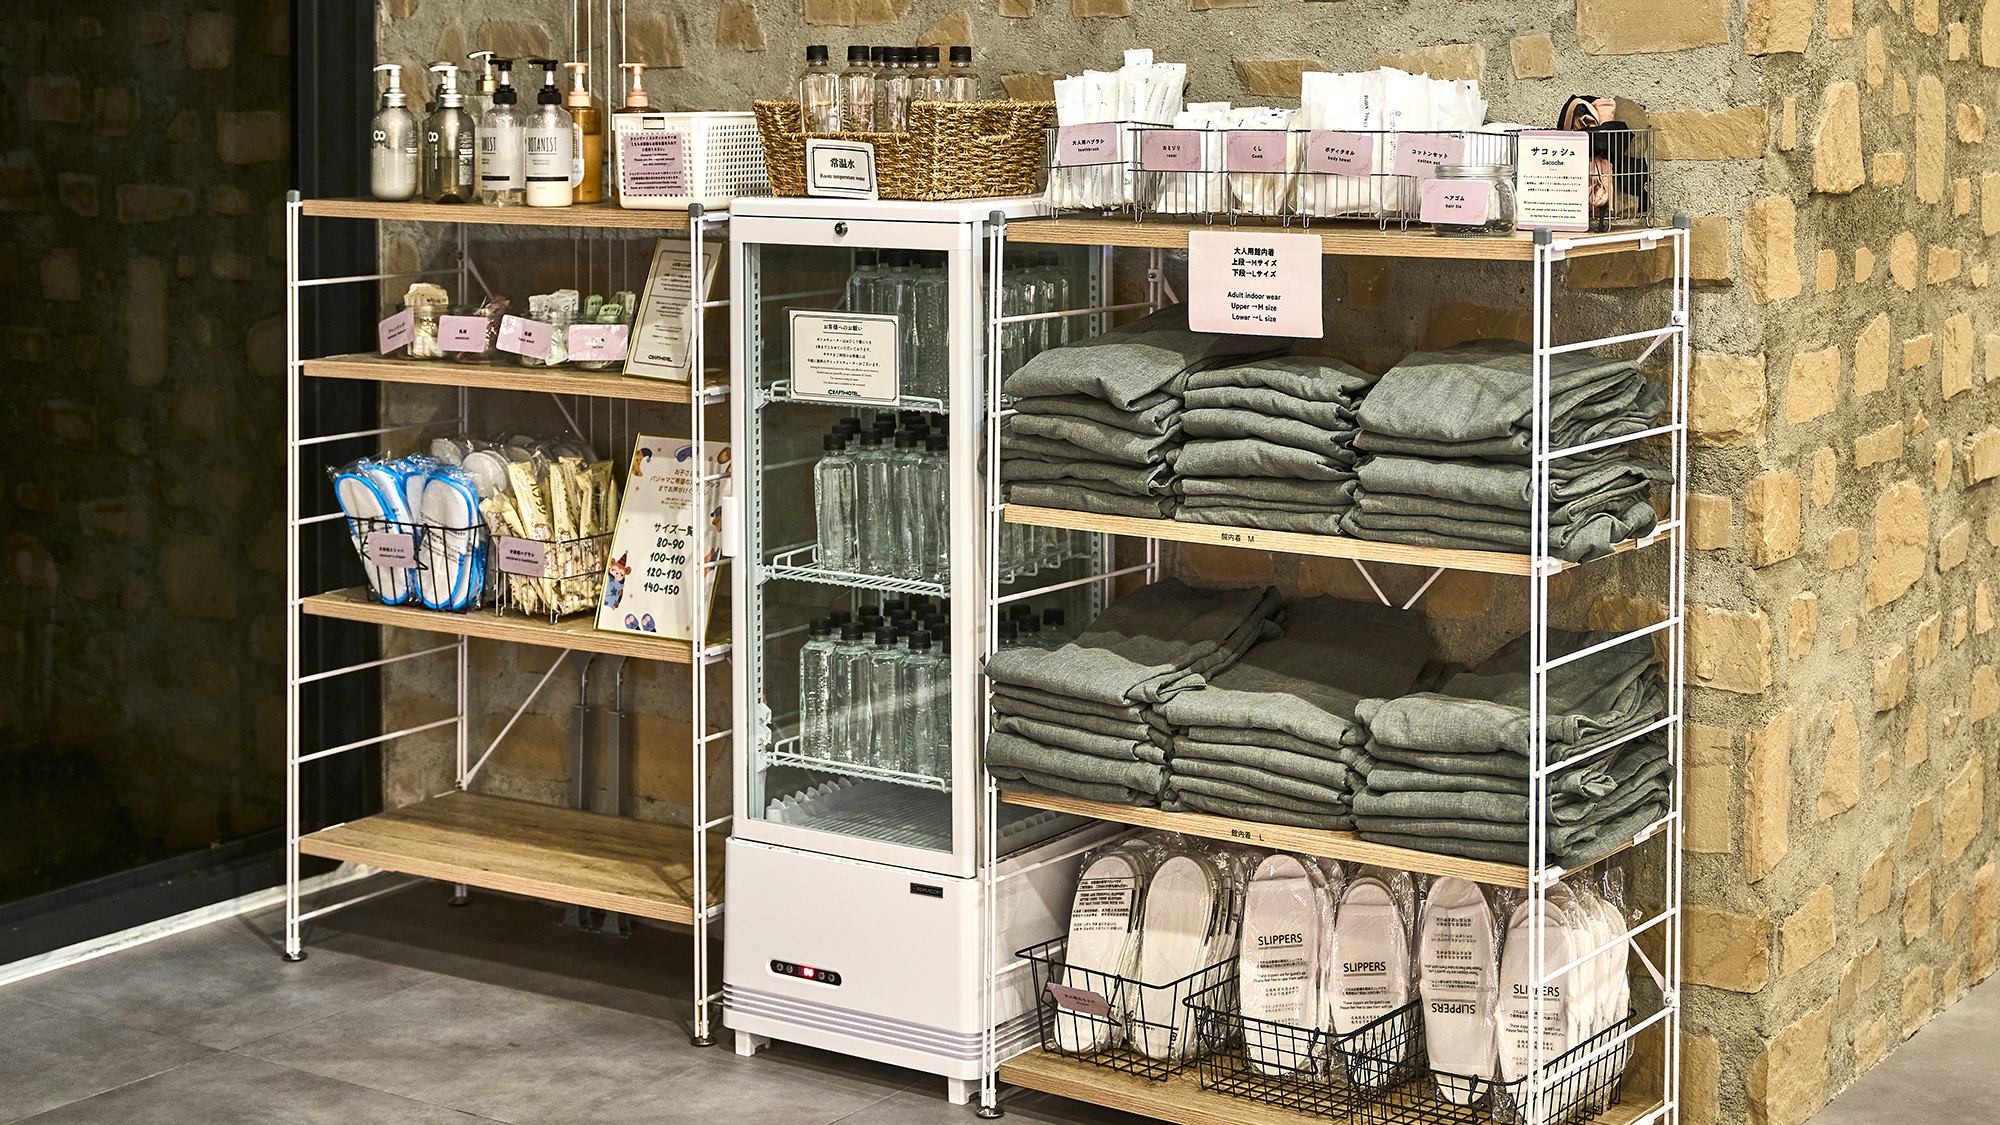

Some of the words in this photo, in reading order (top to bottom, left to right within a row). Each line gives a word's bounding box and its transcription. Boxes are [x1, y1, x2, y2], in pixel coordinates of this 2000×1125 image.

[1325, 147, 1355, 156] ボディタオル
[1412, 150, 1448, 158] コットンセット
[1531, 147, 1575, 156] サコッシュ
[830, 158, 855, 169] 常温水
[1234, 247, 1274, 256] 大人用館内着
[1221, 533, 1240, 542] 館内着
[656, 537, 684, 550] 80-90
[649, 553, 685, 565] 100-110
[646, 568, 682, 580] 120-130
[644, 582, 679, 595] 140-150
[1231, 829, 1251, 839] 館内着
[1258, 933, 1302, 945] SLIPPERS
[1344, 962, 1386, 972] SLIPPERS
[1431, 1003, 1475, 1014] SLIPPERS
